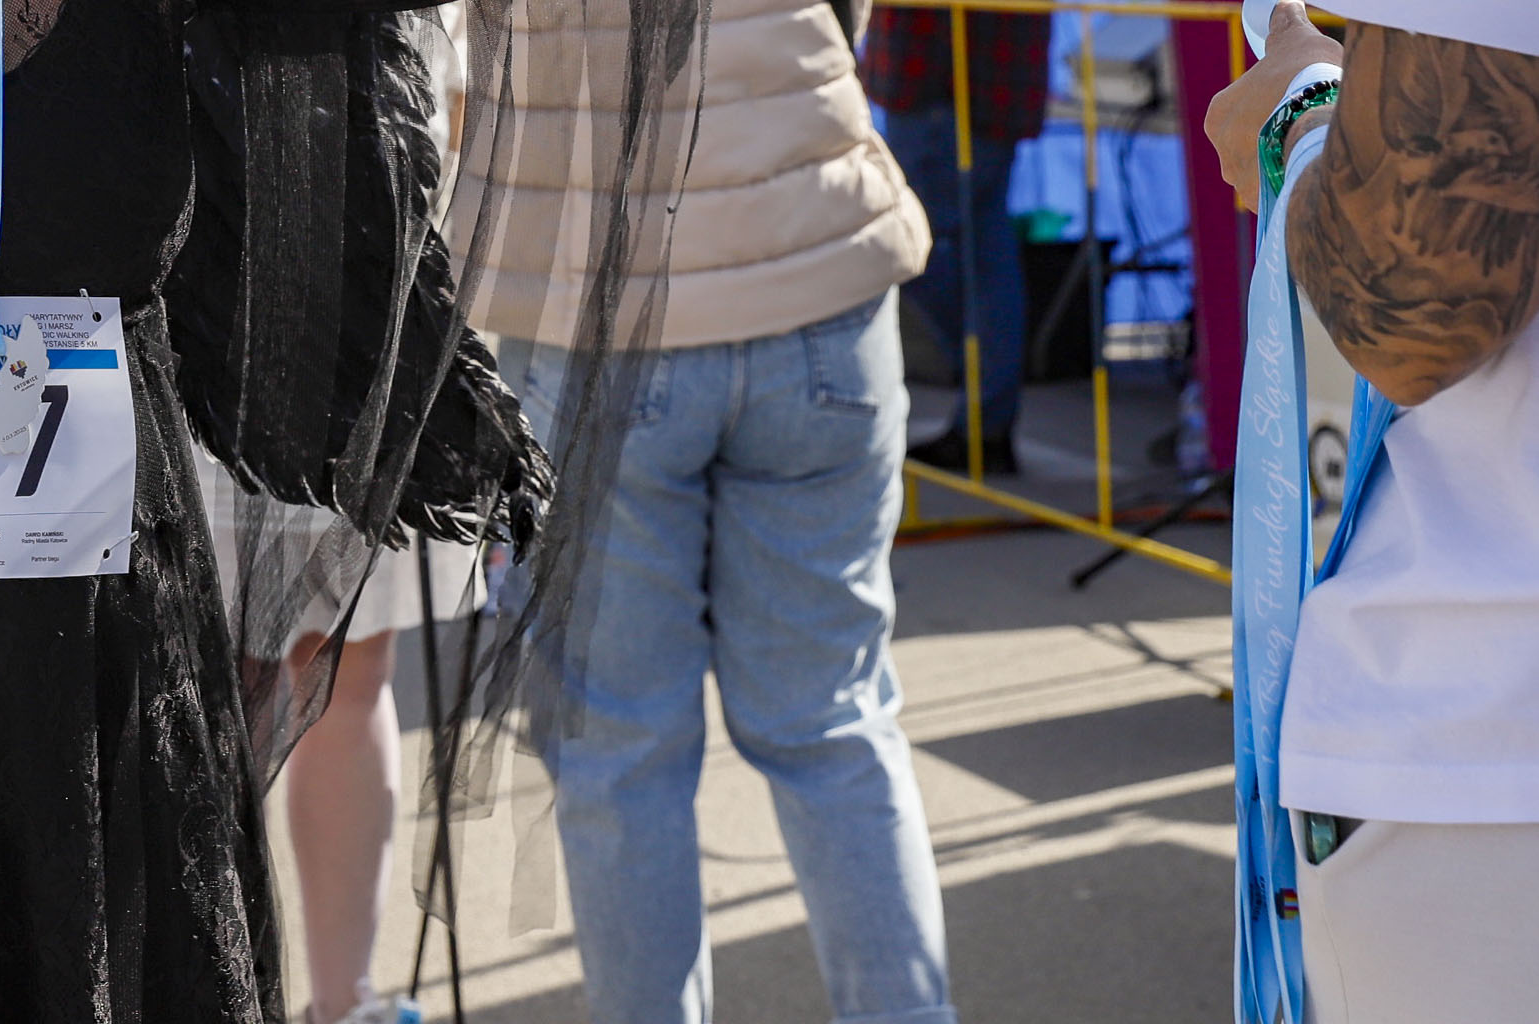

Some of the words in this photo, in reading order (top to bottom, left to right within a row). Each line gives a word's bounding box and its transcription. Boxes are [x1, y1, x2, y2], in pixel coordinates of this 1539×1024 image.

[28, 313, 84, 321] HARYTATYWNY
[57, 331, 90, 339] WALKING
[86, 340, 98, 348] KM
[1246, 314, 1291, 448] Śląskie
[1253, 454, 1300, 620] Fundacji
[1257, 624, 1293, 714] Bieg
